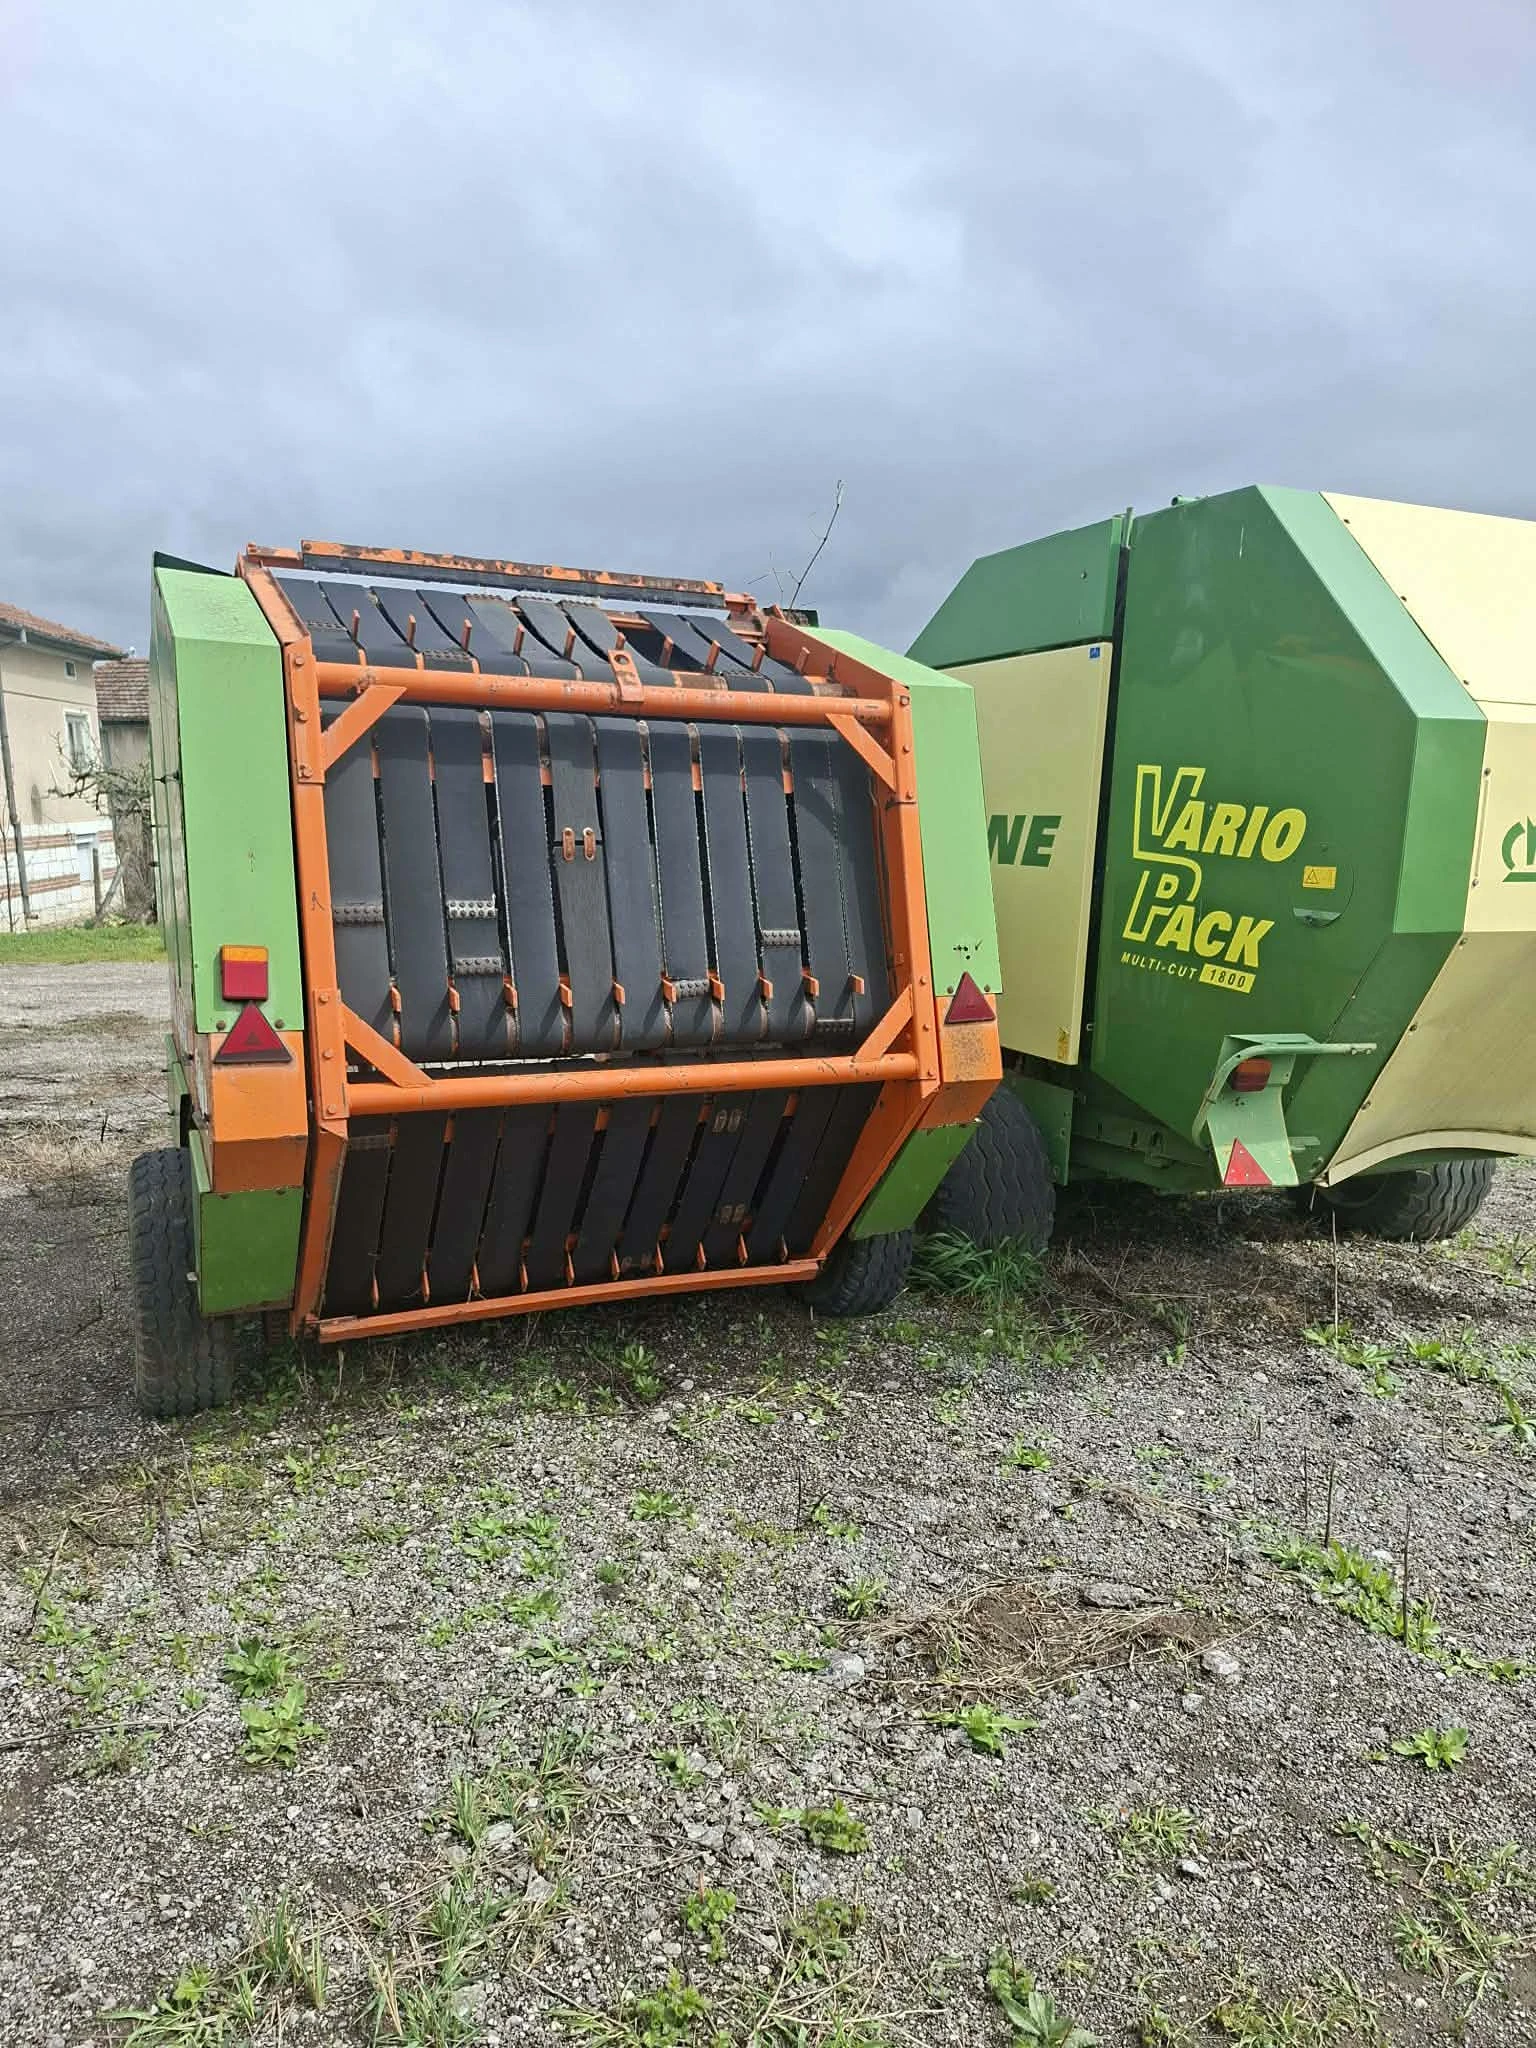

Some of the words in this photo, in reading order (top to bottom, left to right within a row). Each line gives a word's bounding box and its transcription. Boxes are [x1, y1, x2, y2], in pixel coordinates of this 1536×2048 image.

[1133, 764, 1307, 863] VARIO
[1122, 852, 1275, 968] PACK
[1120, 951, 1198, 980] MULTI-CUT
[1209, 968, 1246, 988] 1800
